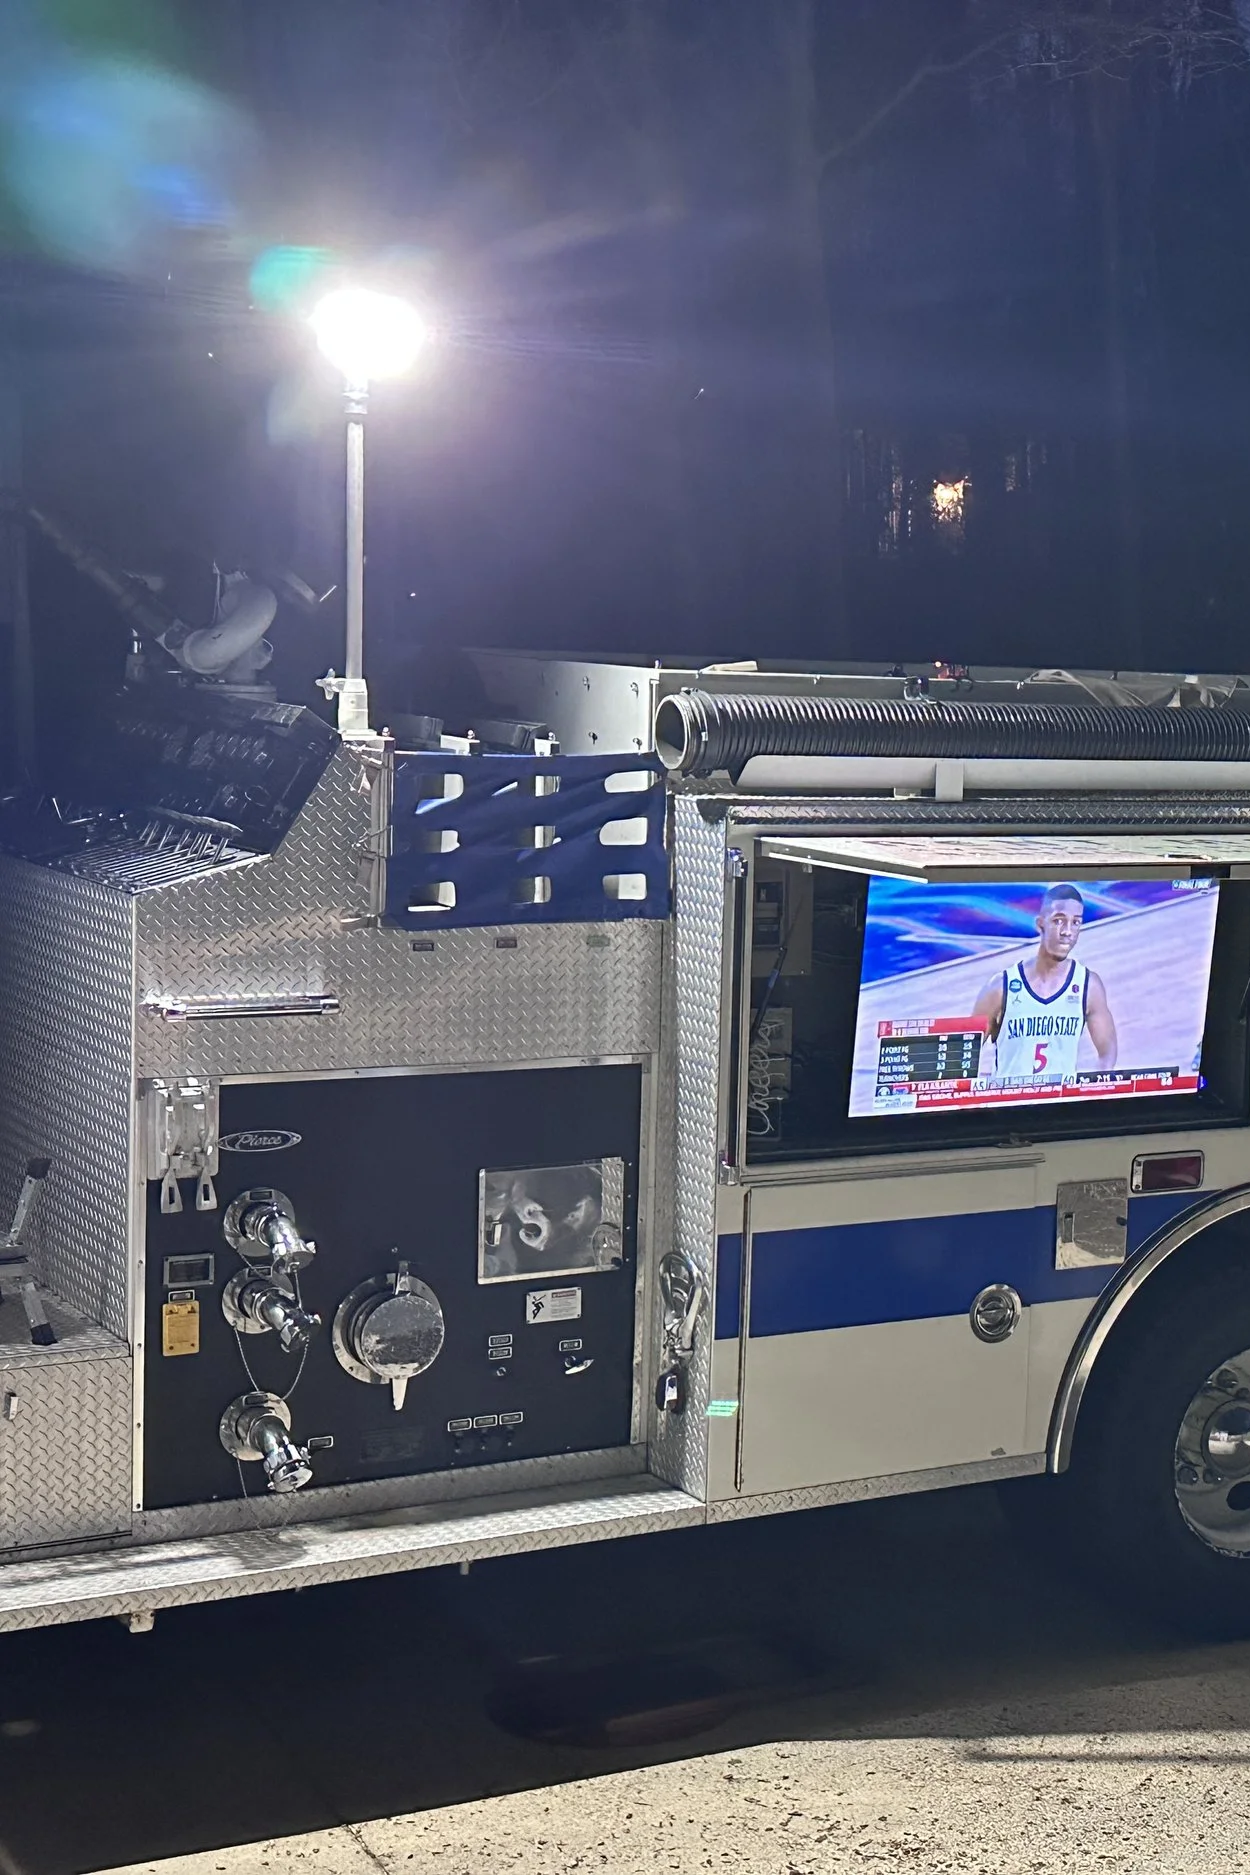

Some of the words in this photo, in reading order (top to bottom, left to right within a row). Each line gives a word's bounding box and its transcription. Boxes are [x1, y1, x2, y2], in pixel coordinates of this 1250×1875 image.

[1007, 1018, 1025, 1039] SAN
[1026, 1015, 1054, 1036] DIEGO
[1054, 1015, 1080, 1036] STATE
[1033, 1043, 1049, 1074] 5
[234, 1132, 282, 1149] Pierce
